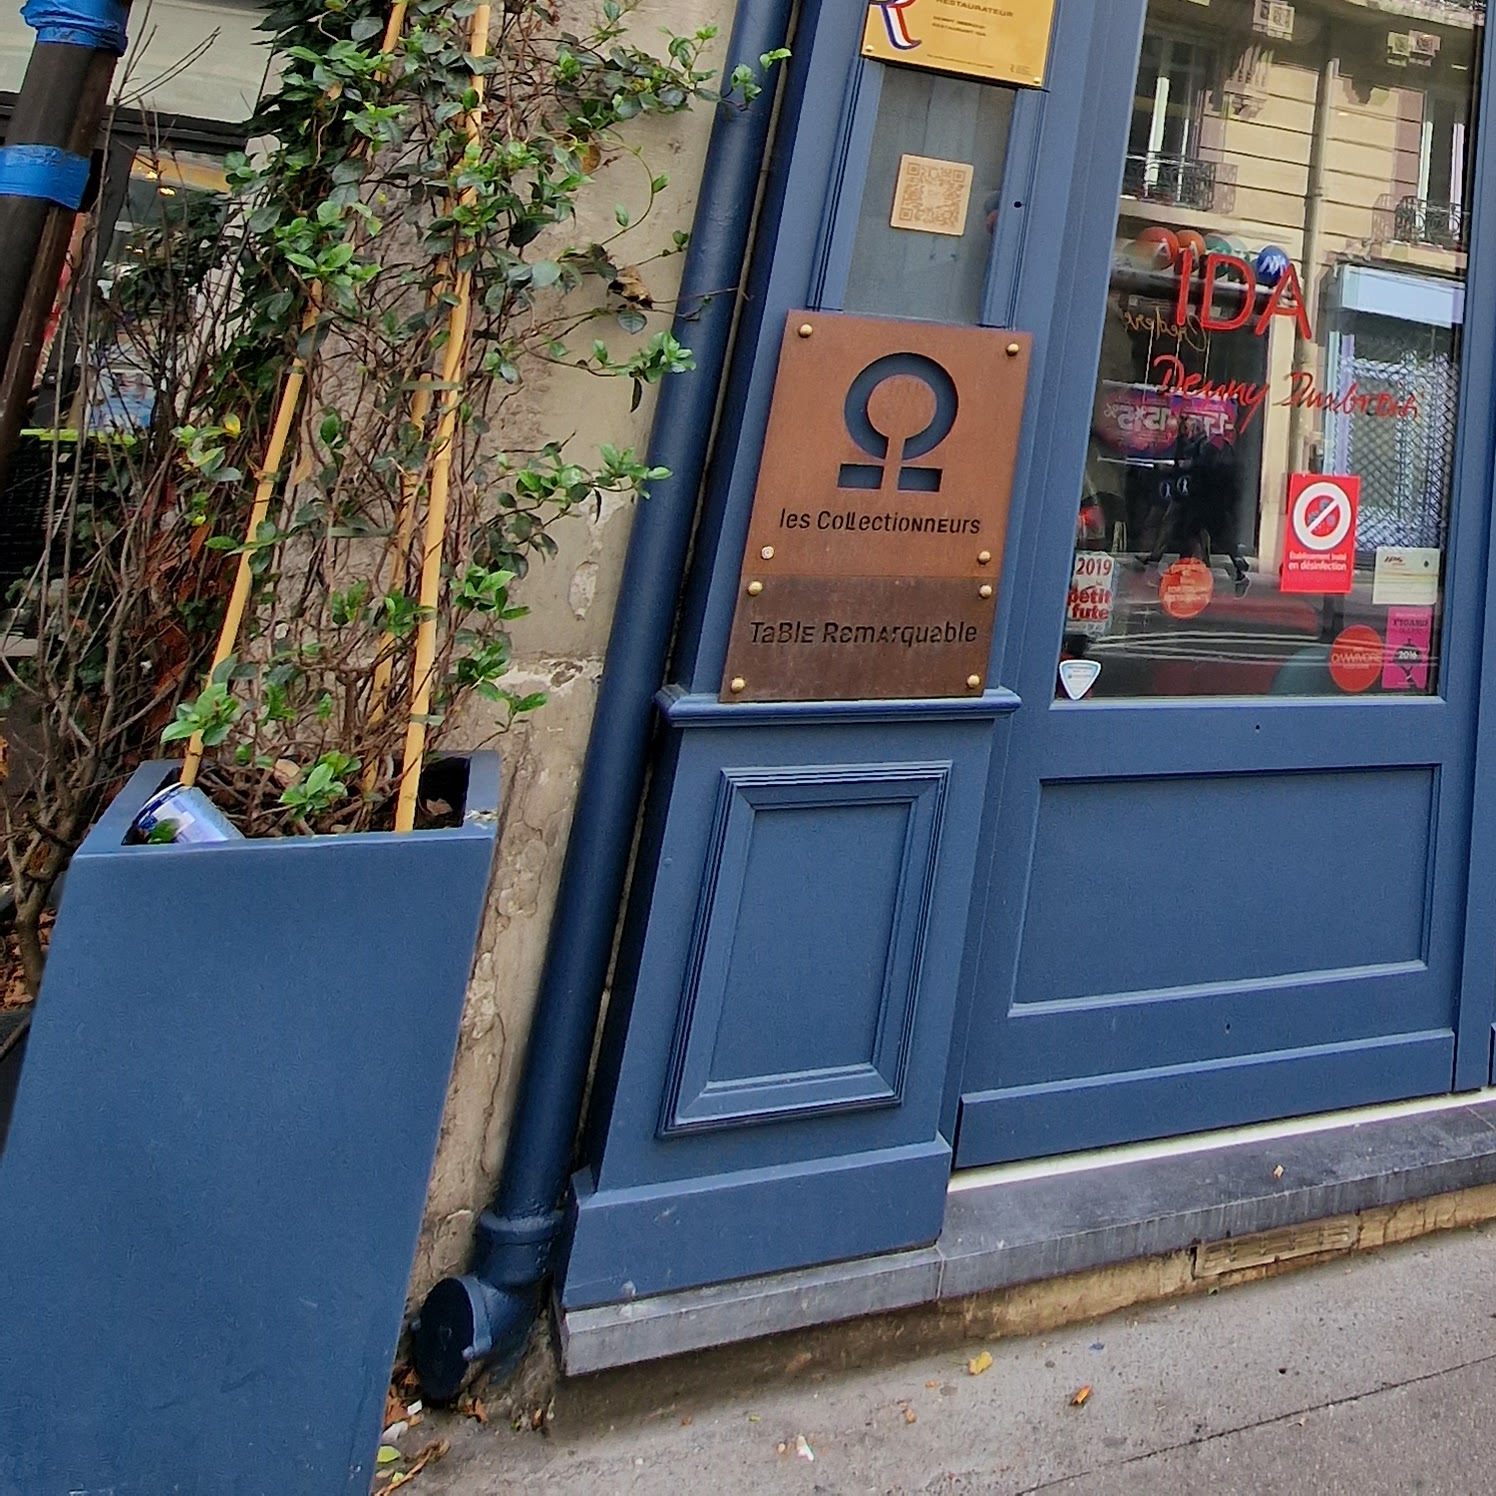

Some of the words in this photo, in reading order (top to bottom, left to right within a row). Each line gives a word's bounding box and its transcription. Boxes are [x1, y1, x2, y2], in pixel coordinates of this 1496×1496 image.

[1177, 248, 1312, 341] IDA
[1153, 354, 1271, 434] Denny
[779, 507, 811, 530] les
[1076, 557, 1112, 576] 2019
